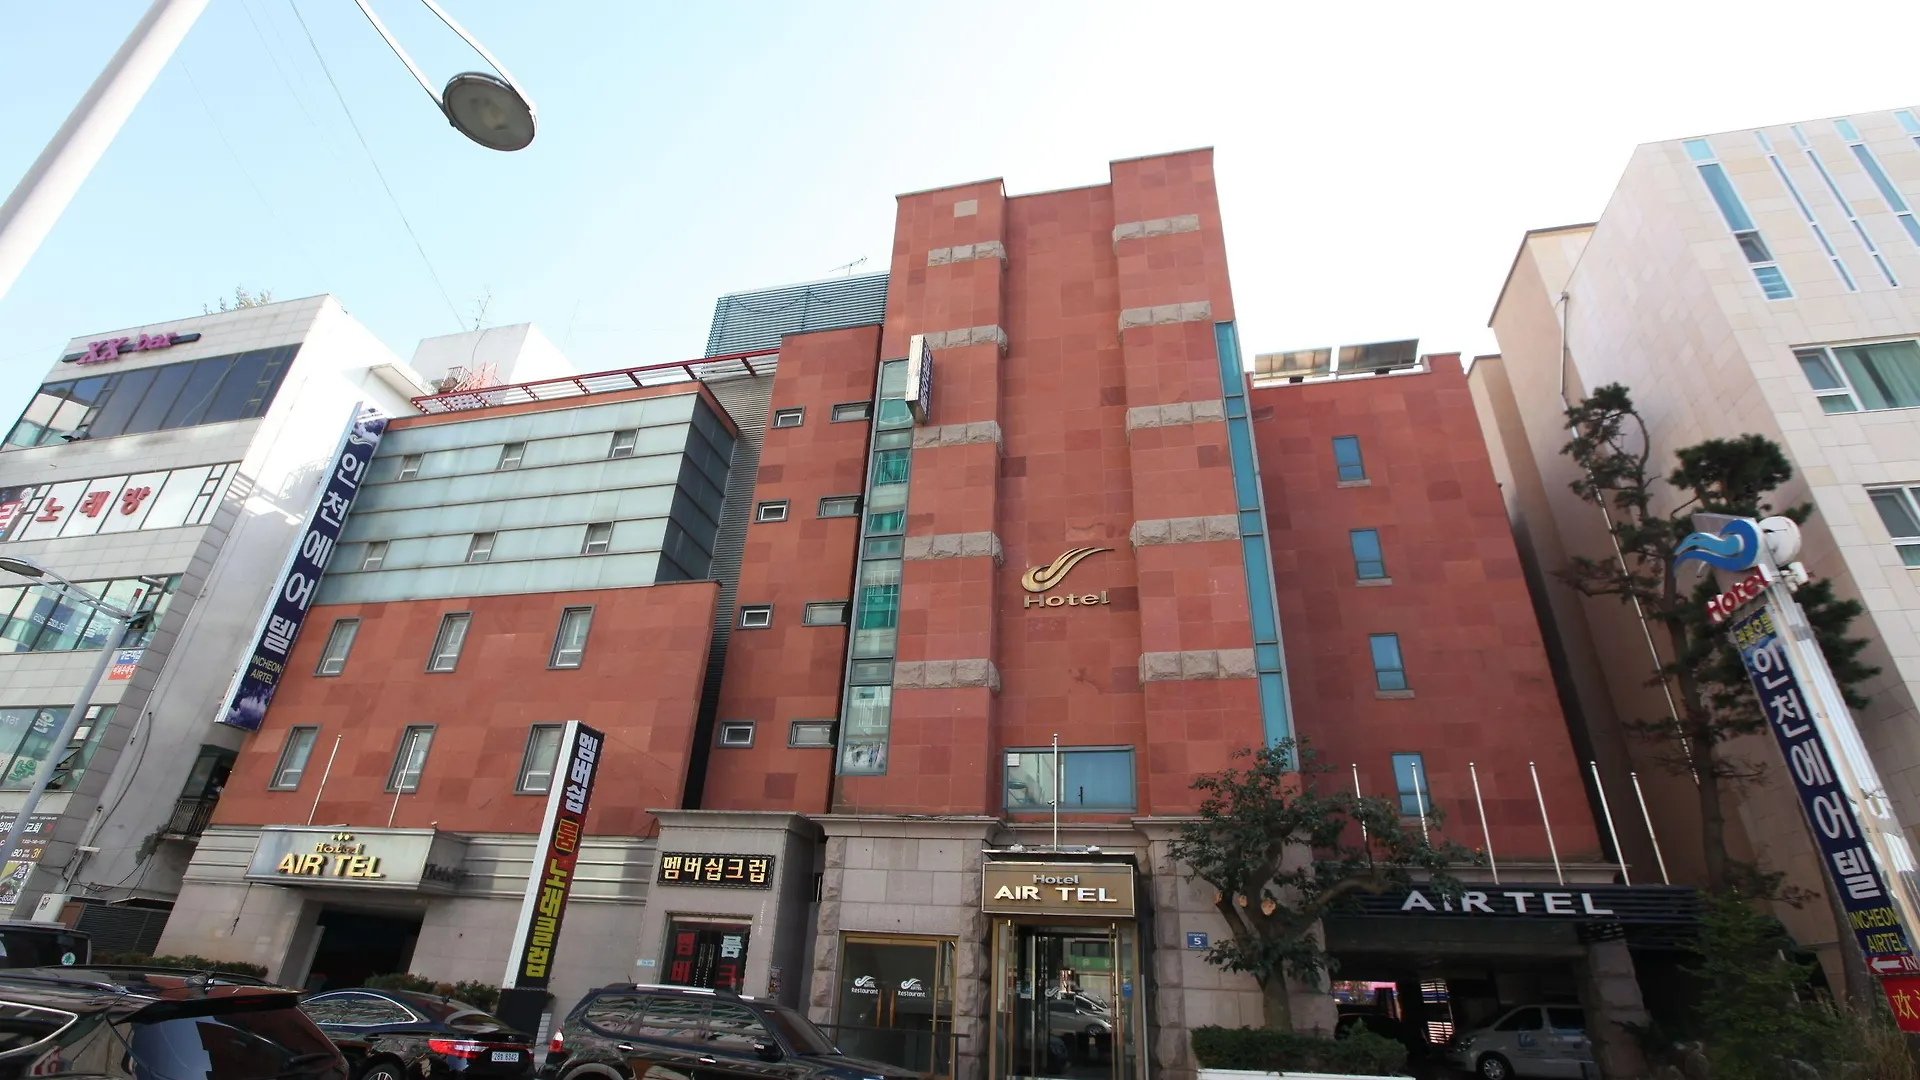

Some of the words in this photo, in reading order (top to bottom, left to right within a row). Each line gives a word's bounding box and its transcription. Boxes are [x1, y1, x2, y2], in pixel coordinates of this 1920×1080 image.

[132, 332, 179, 352] bar
[35, 486, 151, 523] 노래방
[263, 453, 365, 655] 인천에어텔
[1023, 590, 1111, 609] Hotel
[1704, 565, 1768, 624] Hotel
[251, 655, 282, 673] INCHEON
[250, 669, 273, 685] AIRTEL
[1754, 644, 1882, 900] 인천에어텔
[277, 852, 326, 876] AIR
[333, 855, 383, 879] TEL
[663, 856, 768, 883] 멤버쉽크럽
[1032, 874, 1080, 884] Hotel
[994, 885, 1042, 901] AIR
[1055, 887, 1118, 902] TEL
[1849, 905, 1900, 931] INCHEON
[1194, 937, 1202, 945] 5
[1866, 932, 1908, 954] AIRTEL
[851, 987, 879, 995] Restaurant
[897, 990, 926, 998] Restaurant
[1892, 988, 1920, 1020] 欢
